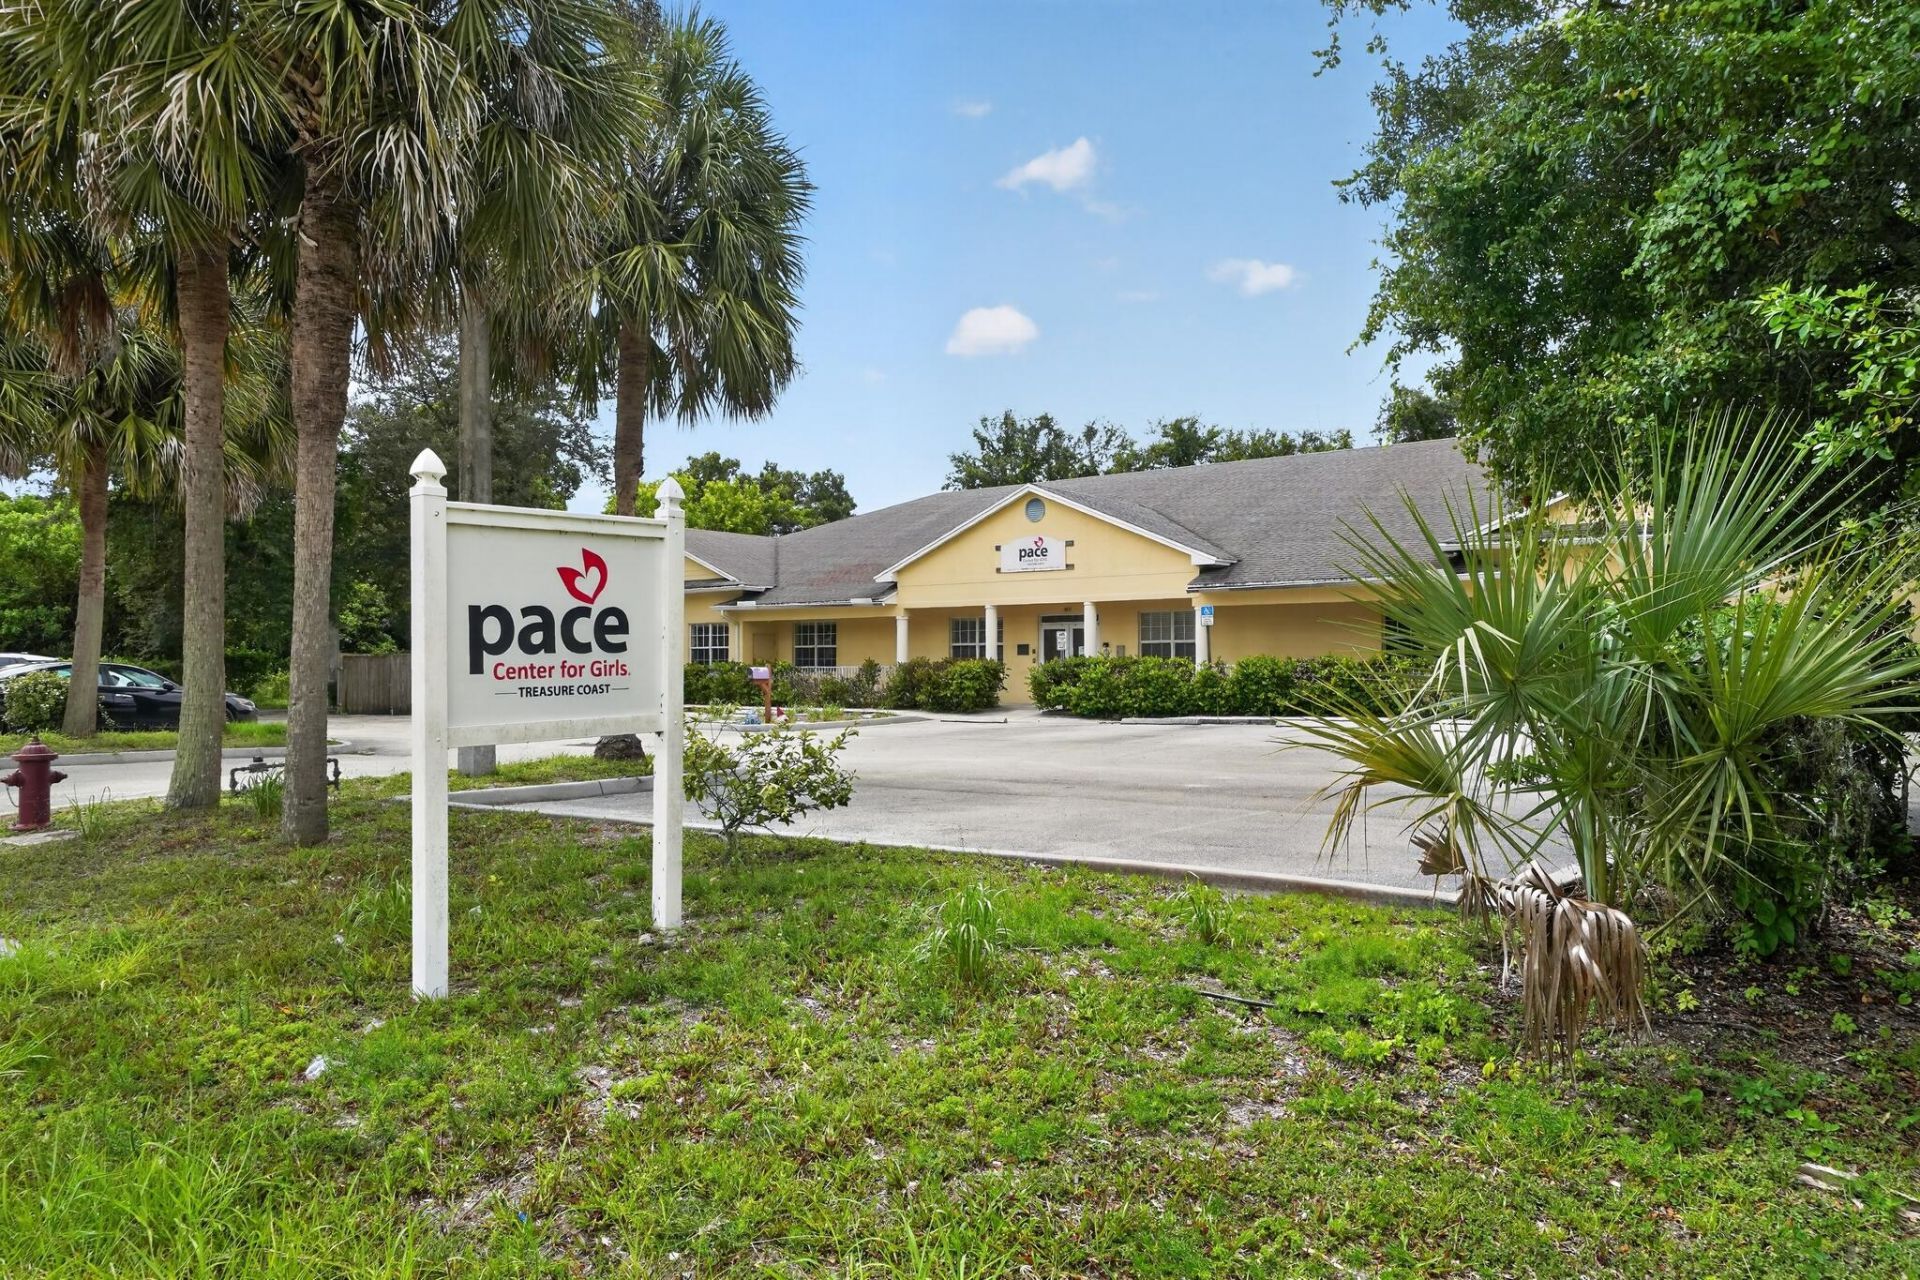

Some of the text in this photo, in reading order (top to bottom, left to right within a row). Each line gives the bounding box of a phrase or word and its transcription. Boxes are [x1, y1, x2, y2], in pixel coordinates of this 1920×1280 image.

[1018, 547, 1048, 562] pace
[468, 604, 630, 675] pace
[493, 662, 555, 681] Center
[560, 660, 586, 678] for
[518, 684, 611, 698] TREASURE COAST
